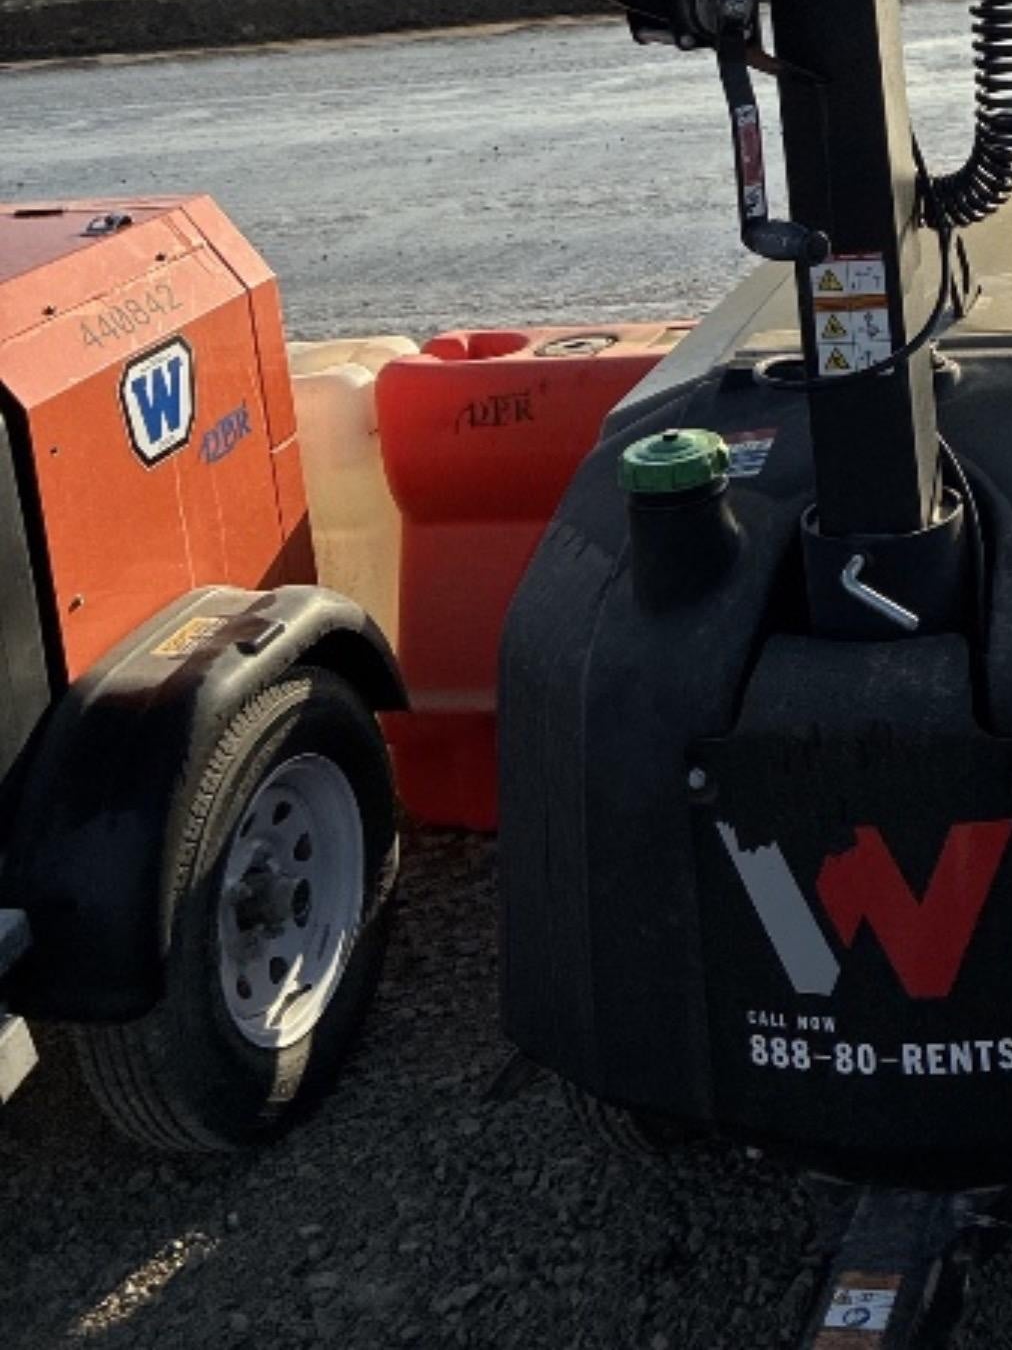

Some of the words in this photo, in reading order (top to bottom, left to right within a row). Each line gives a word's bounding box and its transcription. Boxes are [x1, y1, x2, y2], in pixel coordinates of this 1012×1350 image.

[131, 356, 183, 445] W
[747, 1010, 787, 1028] CALL
[796, 1015, 836, 1033] NOW
